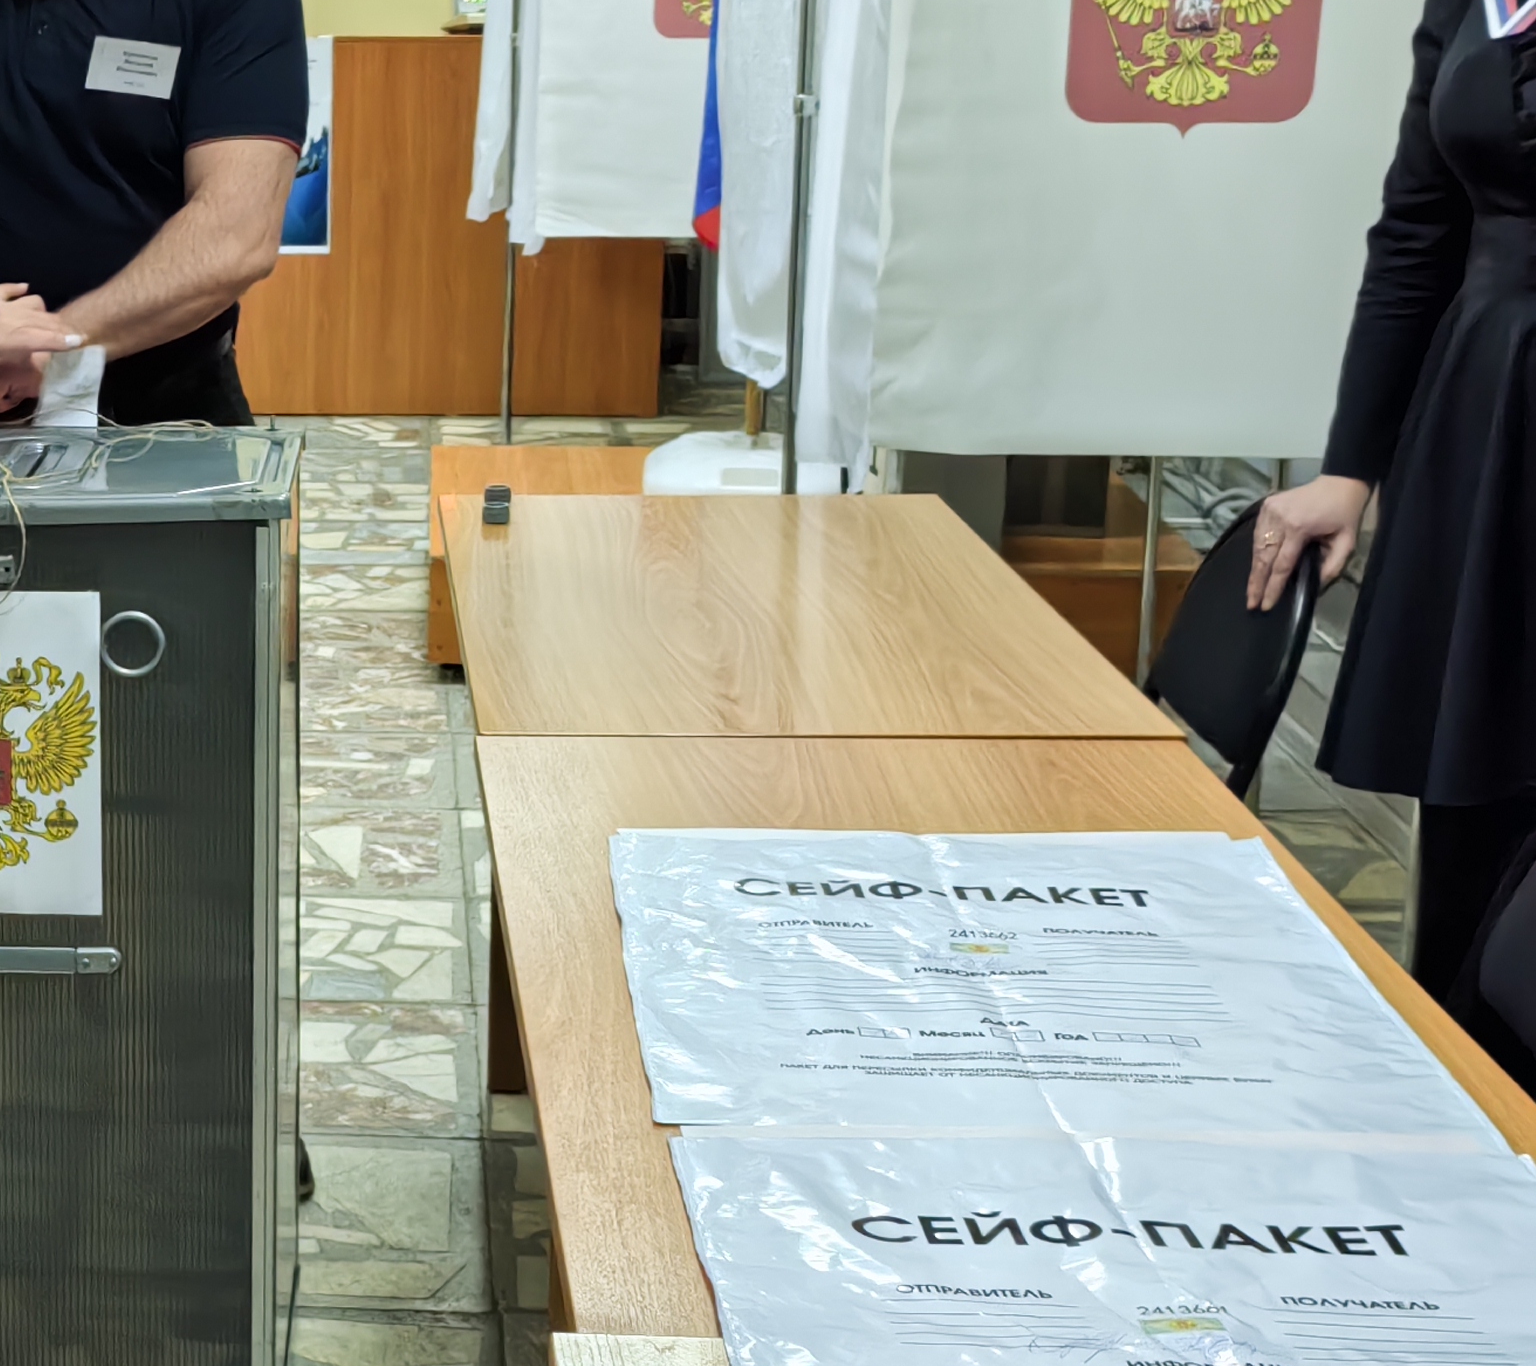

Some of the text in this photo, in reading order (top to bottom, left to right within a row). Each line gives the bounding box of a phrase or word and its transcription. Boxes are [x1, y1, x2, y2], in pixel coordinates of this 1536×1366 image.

[734, 878, 1149, 907] СЕЙФ-ПАКЕТ
[758, 919, 874, 928] ОТПРАВИТЕЛЬ
[1043, 927, 1160, 937] ПОЛУЧАТЕЛЬ
[851, 1210, 1410, 1257] СЕЙФ-ПАКЕТ
[896, 1284, 1053, 1299] ОТПРАВИТЕЛЬ
[1280, 1296, 1440, 1311] ПОЛУЧАТЕЛЬ
